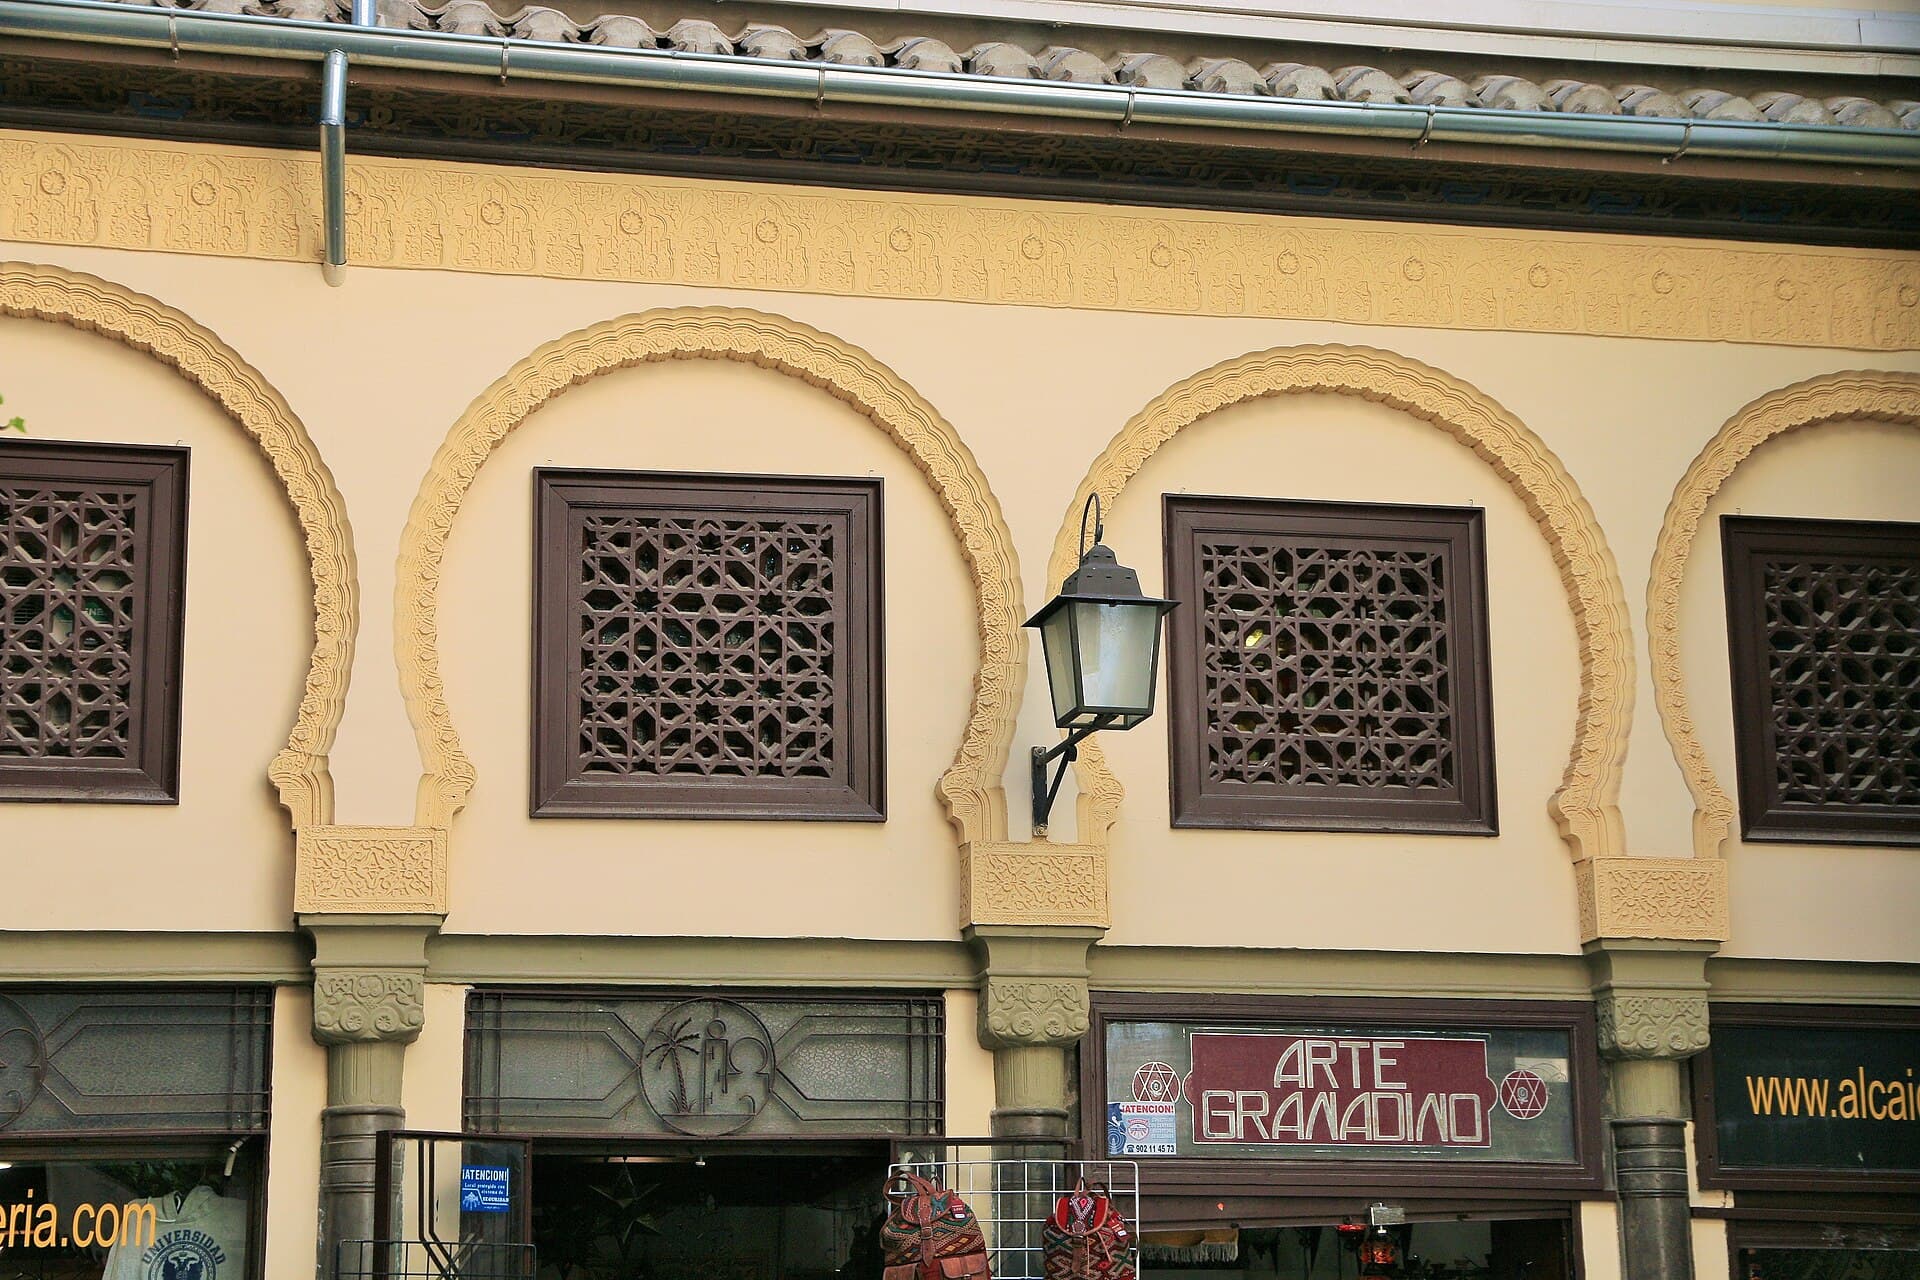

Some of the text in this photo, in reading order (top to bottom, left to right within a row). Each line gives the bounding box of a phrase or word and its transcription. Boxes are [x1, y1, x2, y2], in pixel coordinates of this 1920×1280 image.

[1273, 1040, 1407, 1090] ARTE
[1202, 1090, 1483, 1142] GRANADINO
[1745, 1066, 1920, 1121] www.alcai
[0, 1188, 157, 1248] ria.com
[142, 1230, 226, 1264] UNIVERSIDAD
